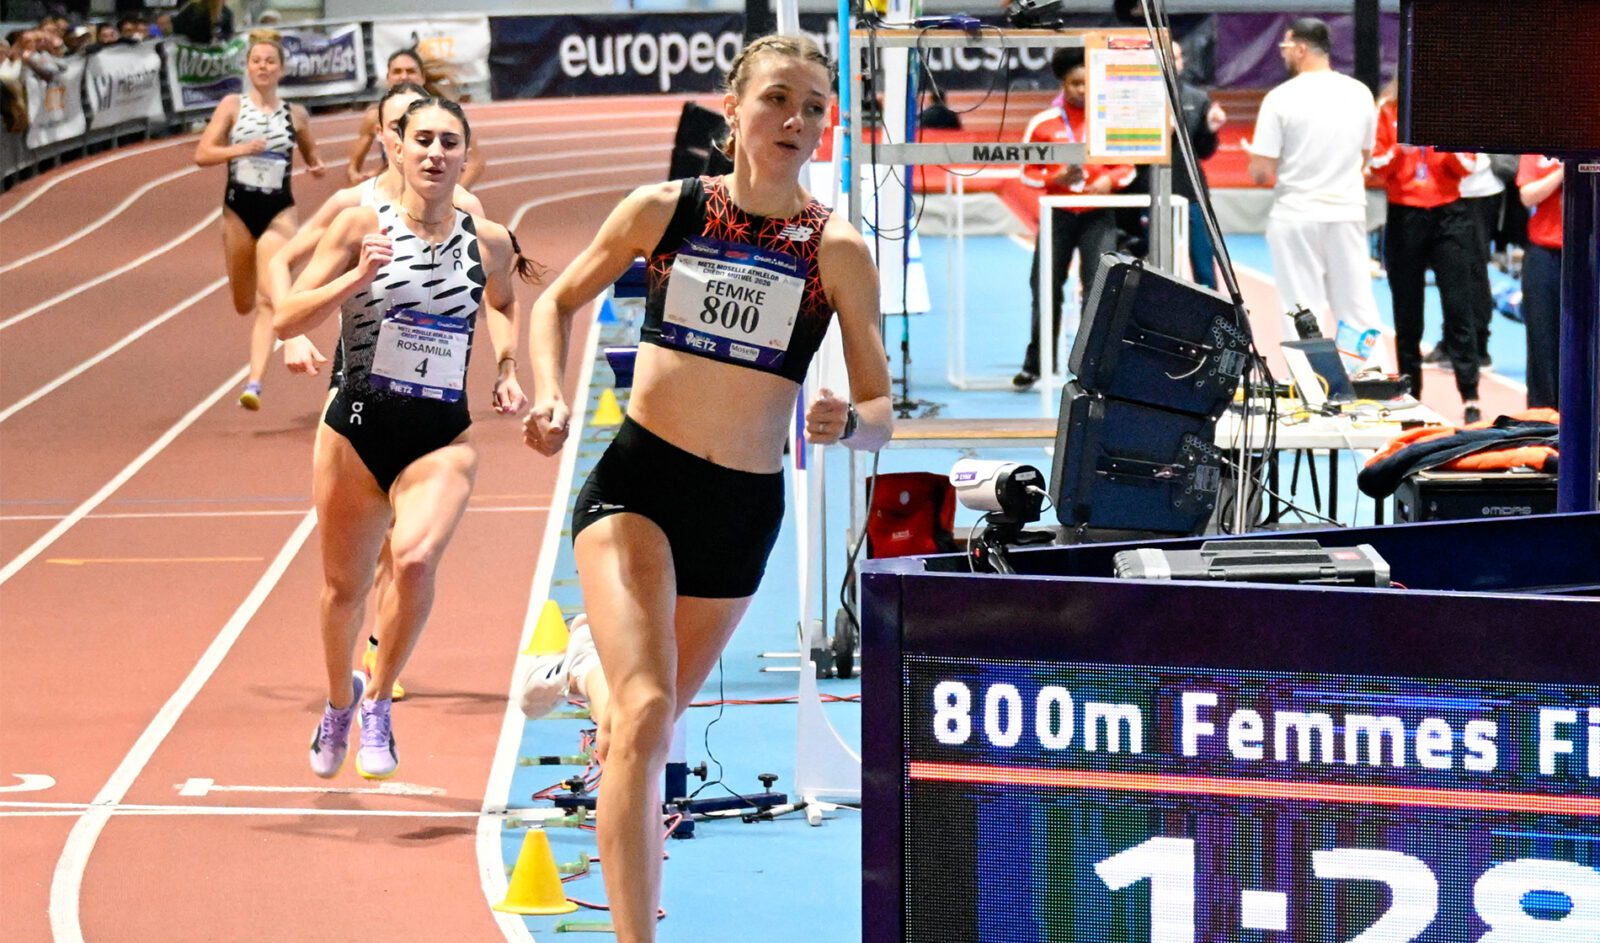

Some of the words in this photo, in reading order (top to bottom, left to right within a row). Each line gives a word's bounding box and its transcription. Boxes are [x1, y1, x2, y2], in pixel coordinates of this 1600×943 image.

[697, 261, 715, 270] METZ
[717, 263, 746, 275] MOSELLE
[747, 268, 780, 281] ATHLELOR
[705, 280, 766, 305] FEMKE
[700, 296, 759, 335] 800
[397, 339, 452, 357] ROSAMILIA
[691, 338, 718, 352] METZ
[415, 357, 429, 378] 4
[932, 680, 1143, 755] 800m
[1180, 691, 1498, 772] Femmes
